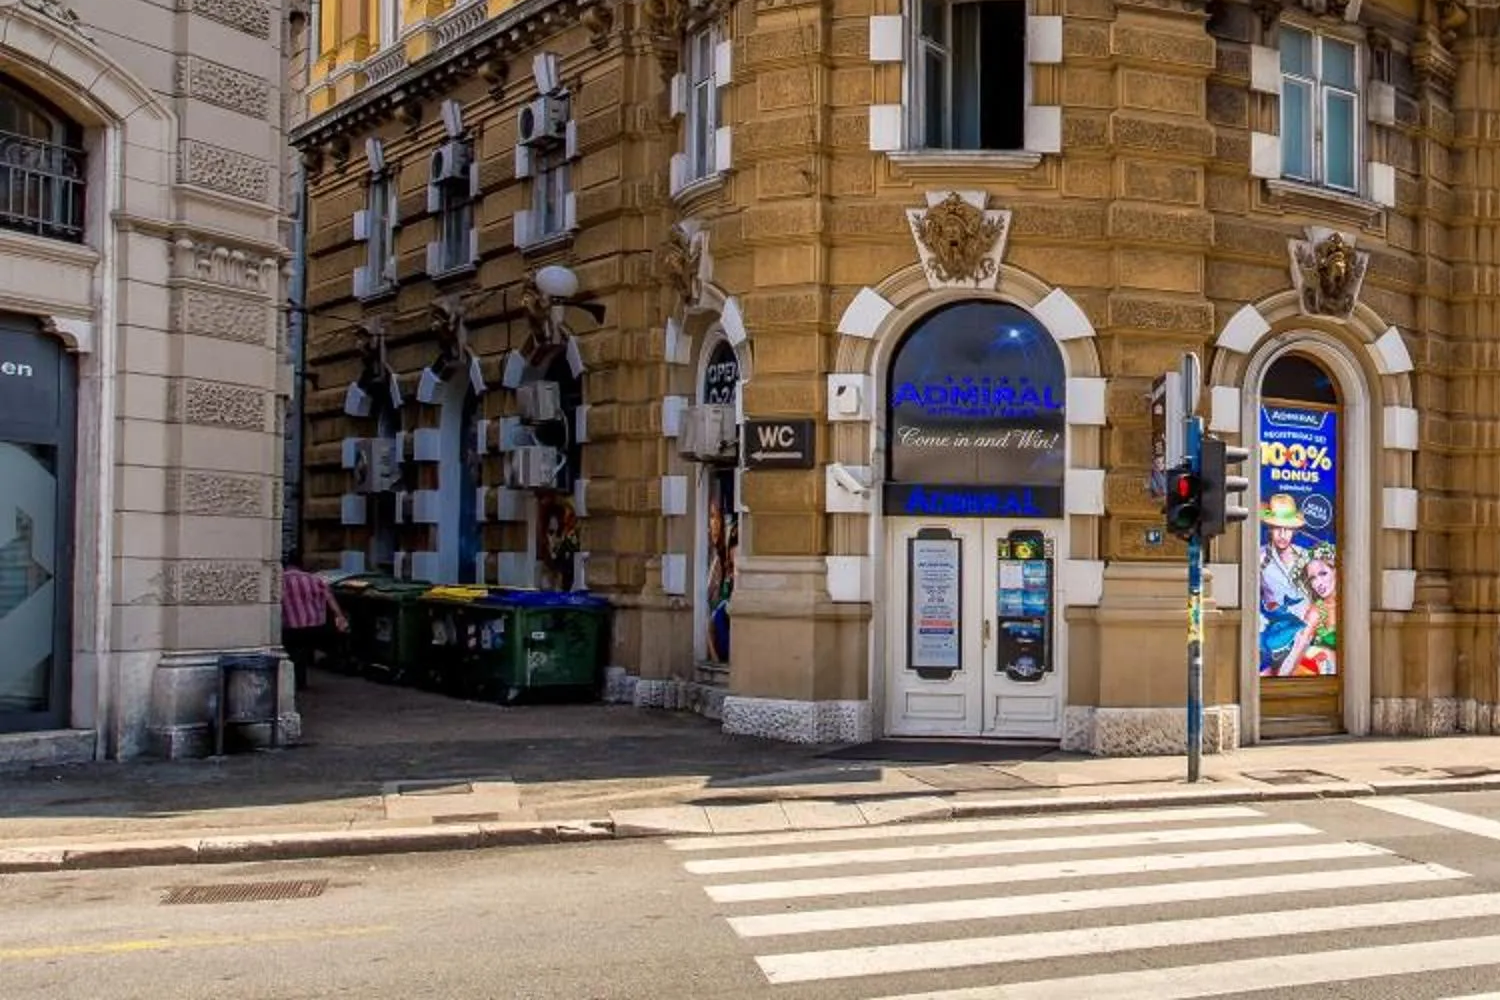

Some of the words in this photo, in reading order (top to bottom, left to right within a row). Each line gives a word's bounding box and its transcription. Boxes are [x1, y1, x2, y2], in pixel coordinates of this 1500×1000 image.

[892, 381, 1064, 408] ADMIRAL
[757, 425, 795, 448] WC
[897, 425, 949, 448] Come
[953, 433, 969, 448] in
[973, 434, 1010, 449] and
[1012, 429, 1060, 450] Win!
[1260, 441, 1332, 470] 100%
[1271, 469, 1320, 483] BONUS
[905, 485, 1041, 514] ADMIRAL
